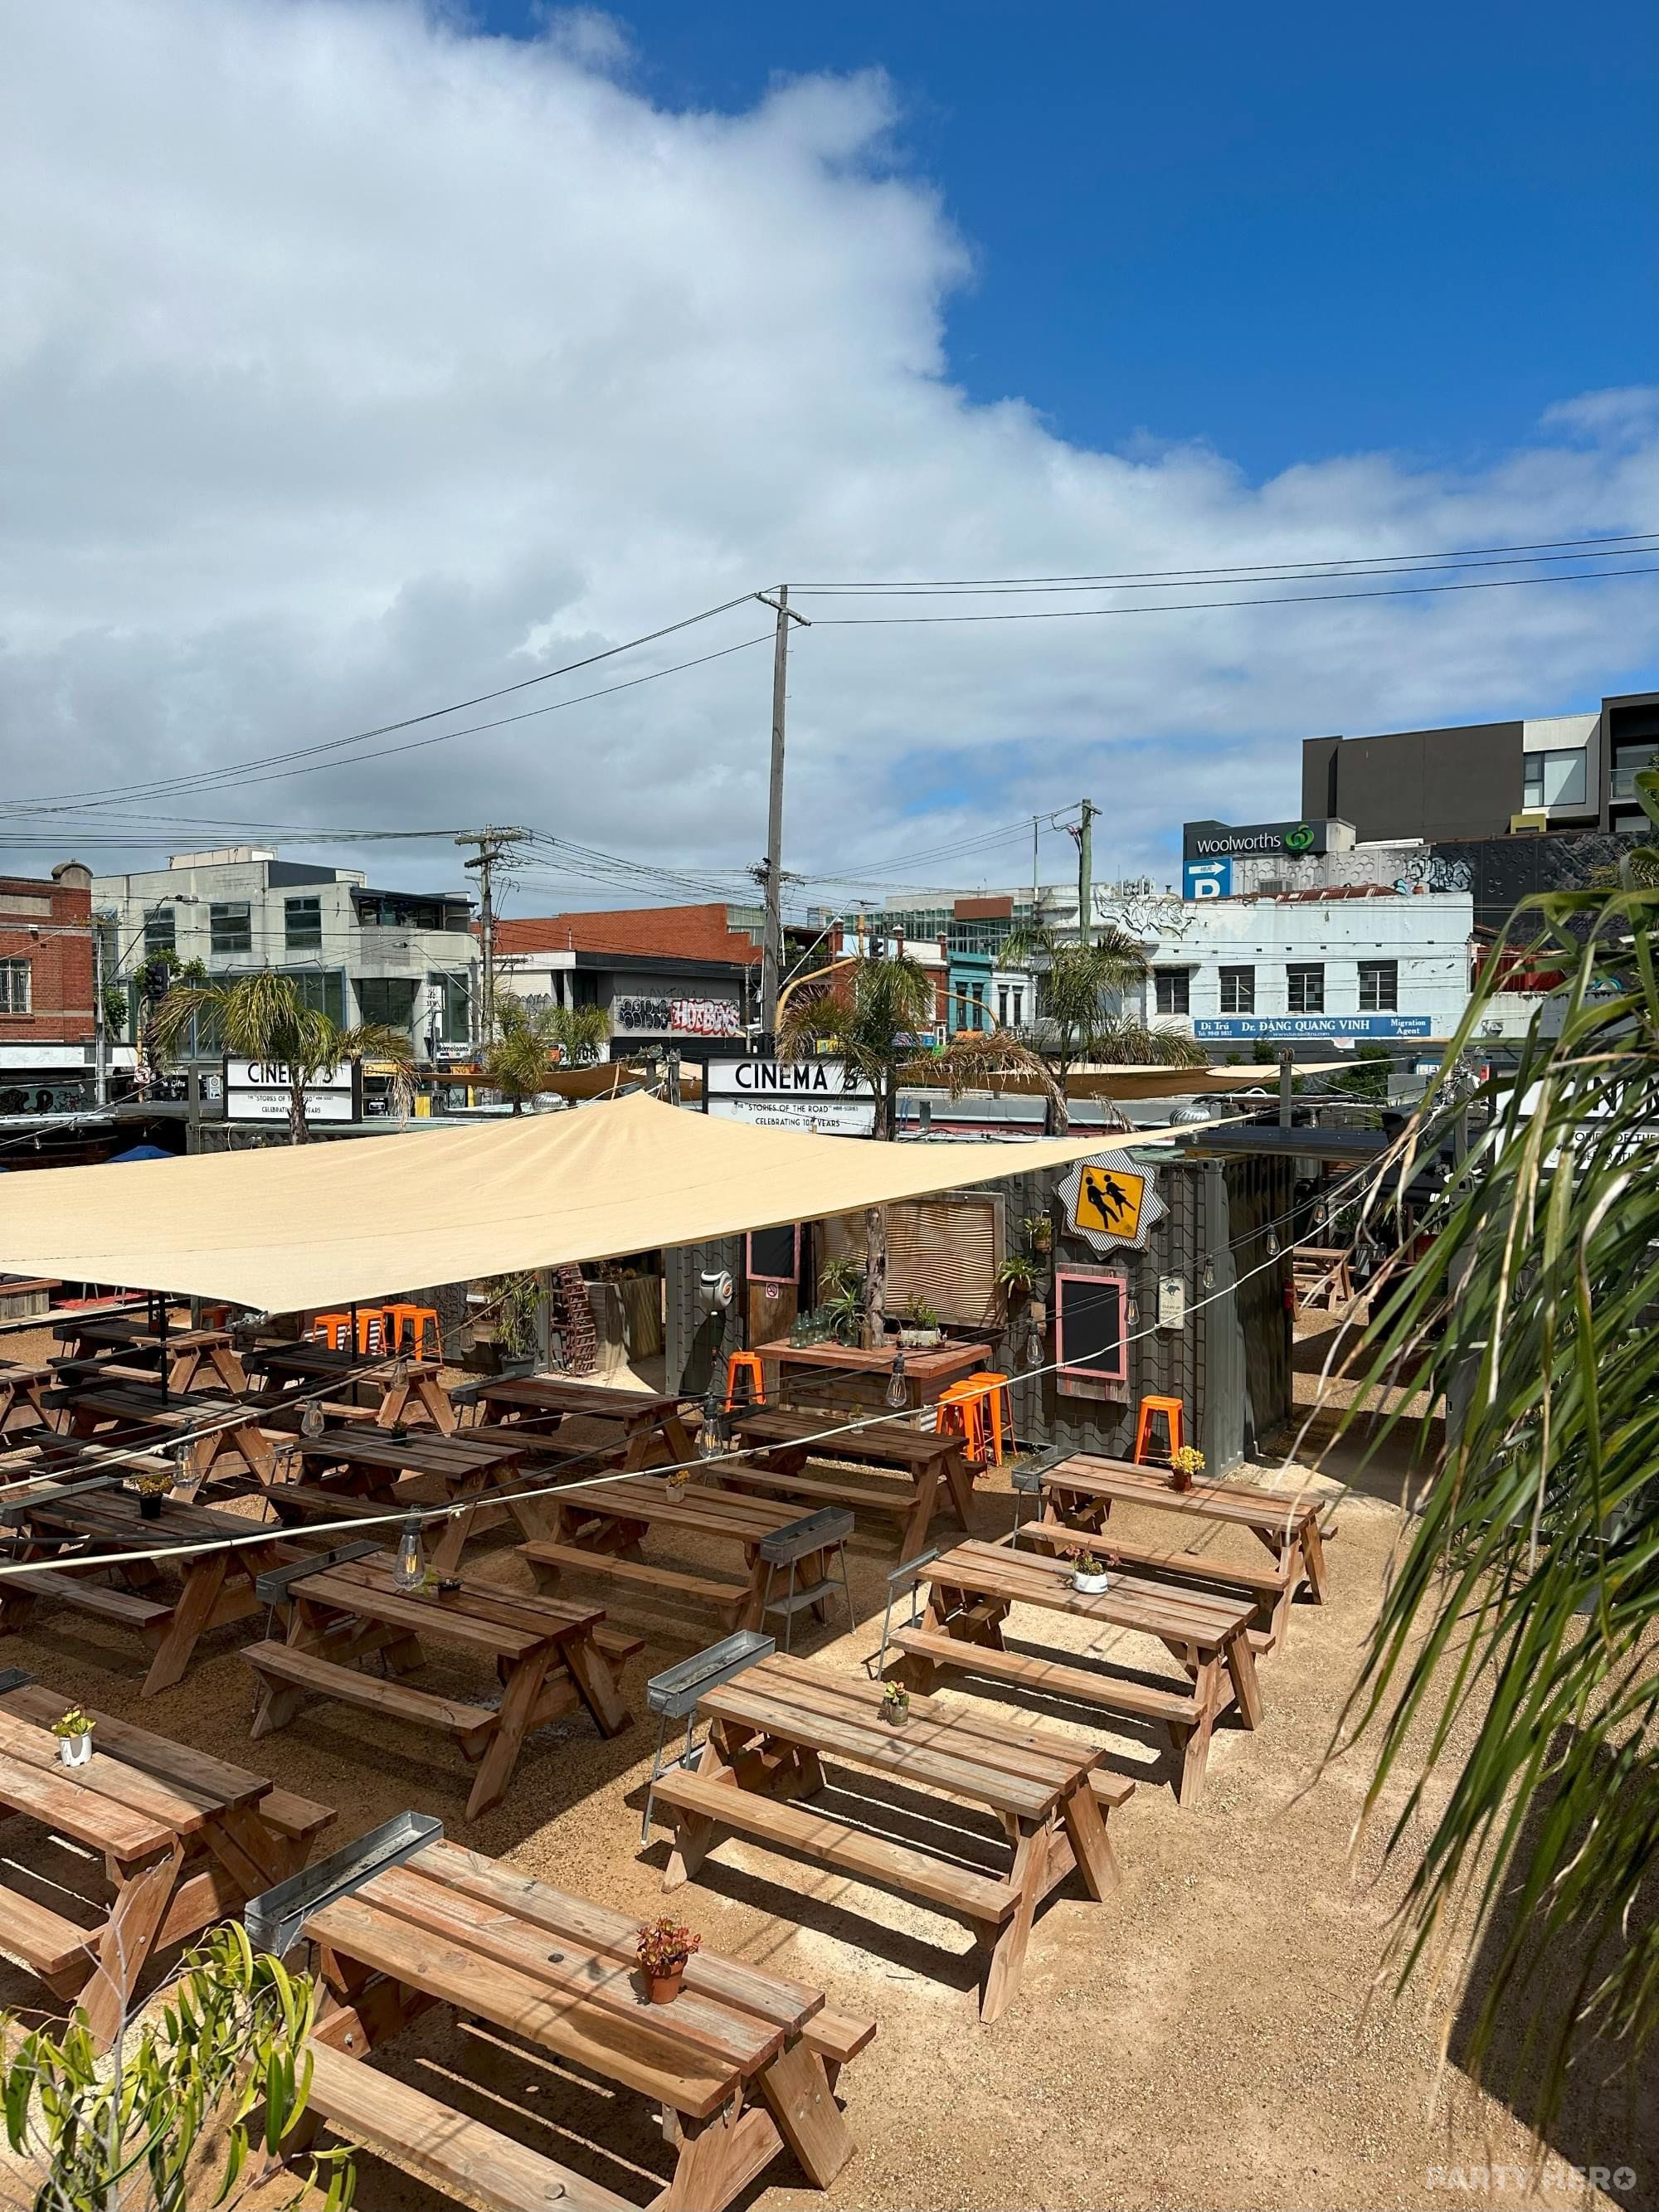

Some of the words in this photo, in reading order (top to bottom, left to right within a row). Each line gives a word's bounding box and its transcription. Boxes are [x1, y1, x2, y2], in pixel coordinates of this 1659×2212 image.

[1194, 878, 1220, 899] P
[1241, 1021, 1256, 1032] Dr.
[1295, 1020, 1335, 1032] QUANG
[1339, 1019, 1370, 1030] VINH
[1390, 1018, 1426, 1028] Migration
[1396, 1027, 1420, 1036] Agent
[735, 1063, 828, 1090] CINEMA
[755, 1117, 800, 1126] CELEBRATING
[817, 1119, 840, 1127] YEARS
